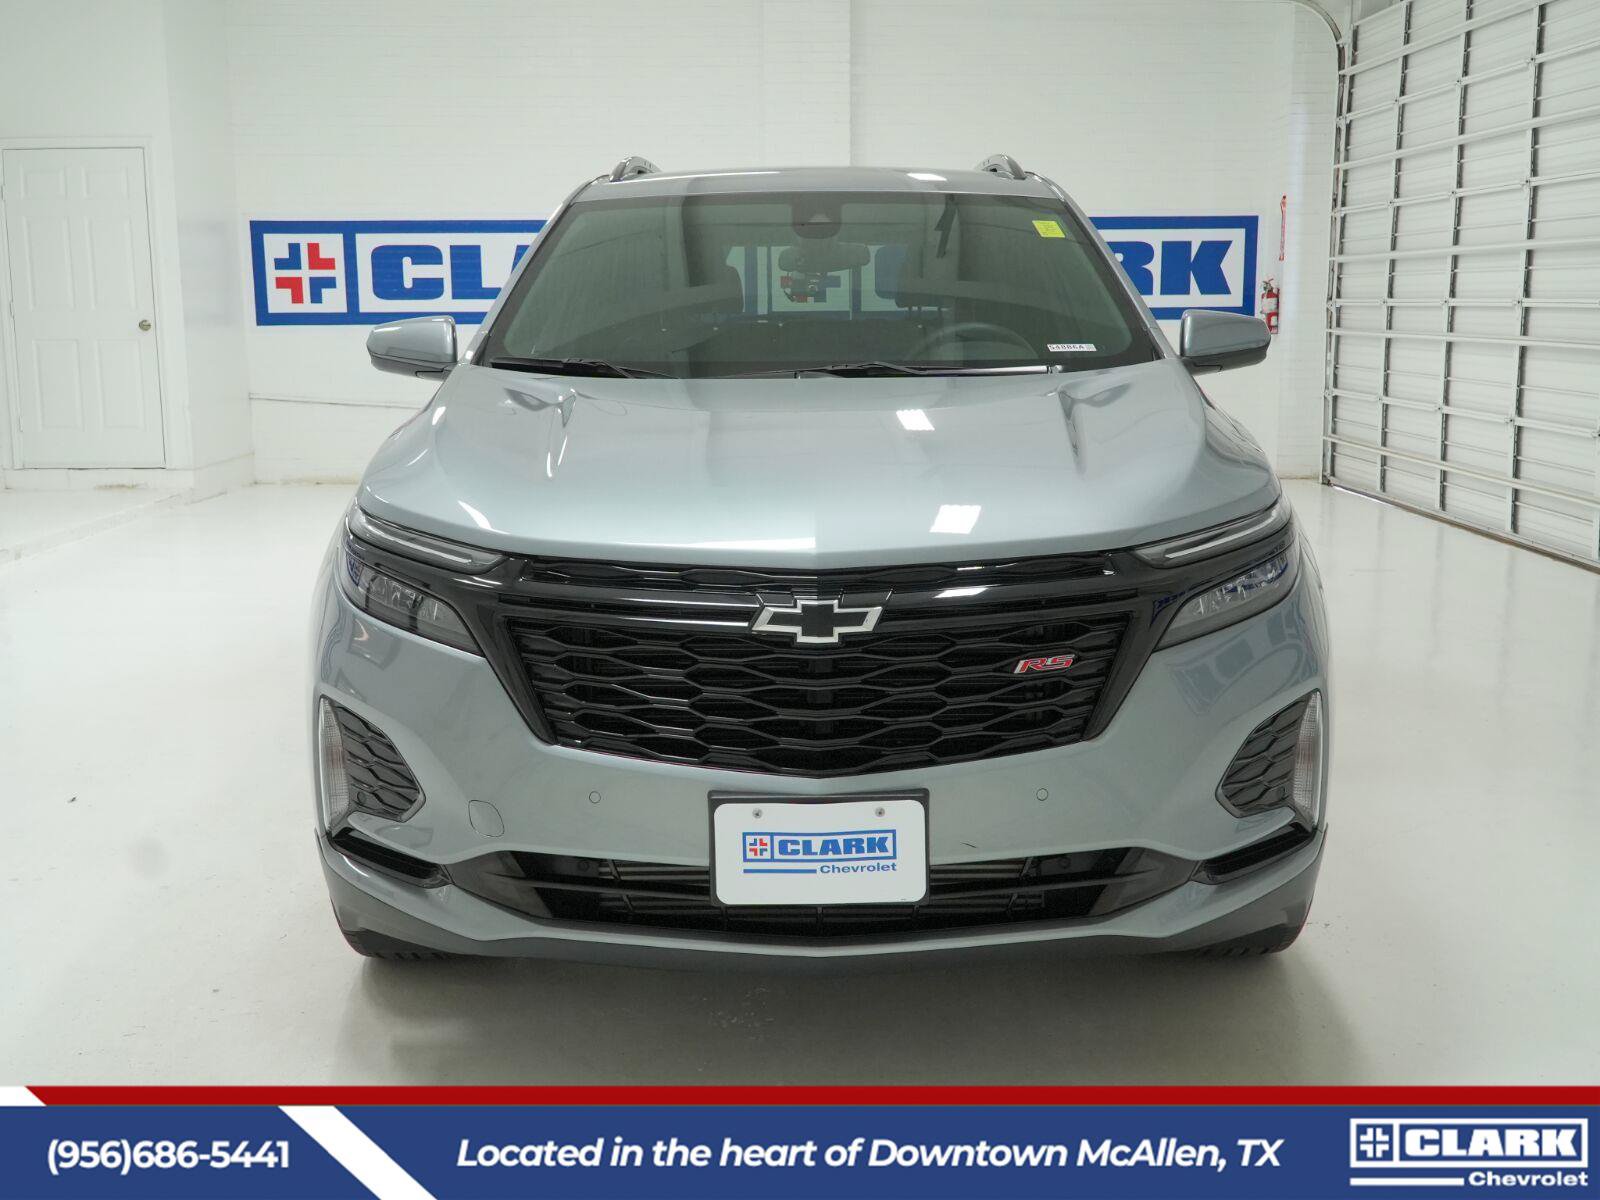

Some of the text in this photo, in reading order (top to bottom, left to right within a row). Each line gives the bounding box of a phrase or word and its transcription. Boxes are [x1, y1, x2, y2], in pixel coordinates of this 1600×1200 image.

[371, 244, 530, 300] CL
[1014, 654, 1075, 673] RS
[778, 836, 889, 856] CLARK
[819, 862, 897, 874] Chevrolet
